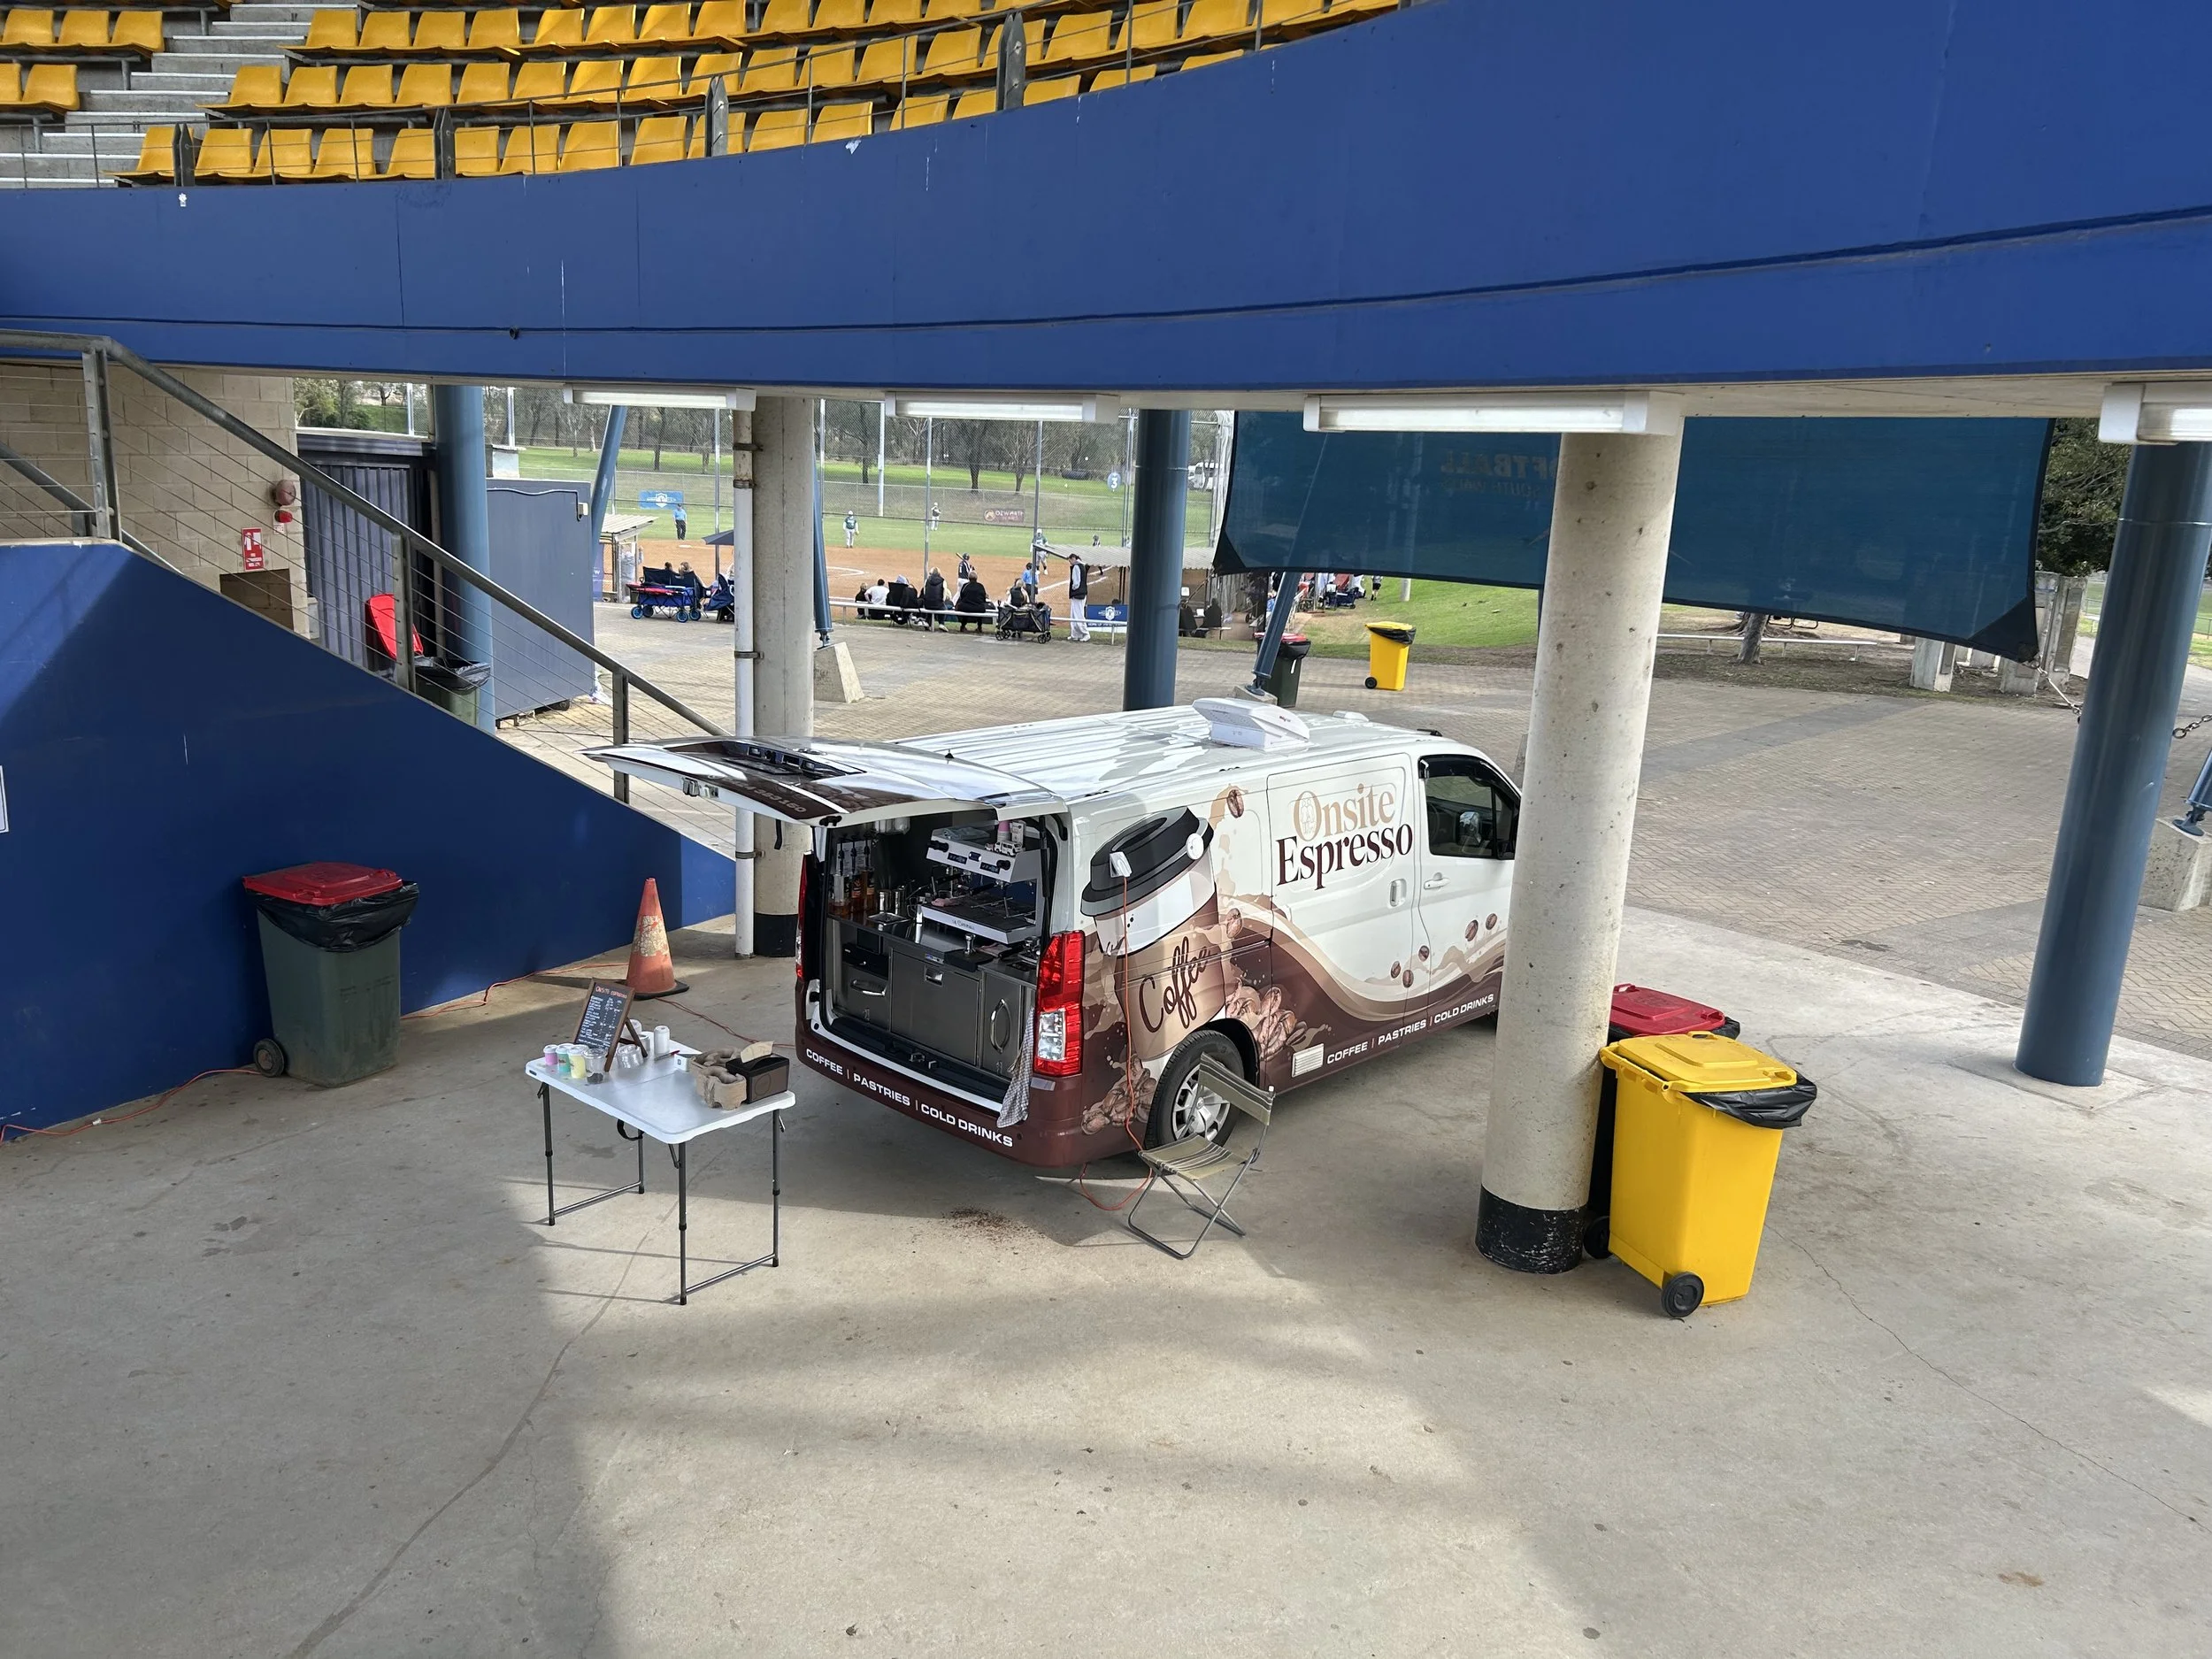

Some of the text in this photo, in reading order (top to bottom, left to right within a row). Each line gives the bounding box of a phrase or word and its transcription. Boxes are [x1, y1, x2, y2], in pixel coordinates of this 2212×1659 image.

[1110, 477, 1118, 488] 3
[779, 800, 806, 811] 160
[1294, 783, 1395, 841] Onsite
[1276, 823, 1413, 890] Espresso
[1139, 936, 1211, 1033] Coffee
[1326, 994, 1494, 1065] COFFEE PASTRIES COLD DRINKS
[806, 1048, 1013, 1148] COFFEE PASTRIES COLD DRINKS
